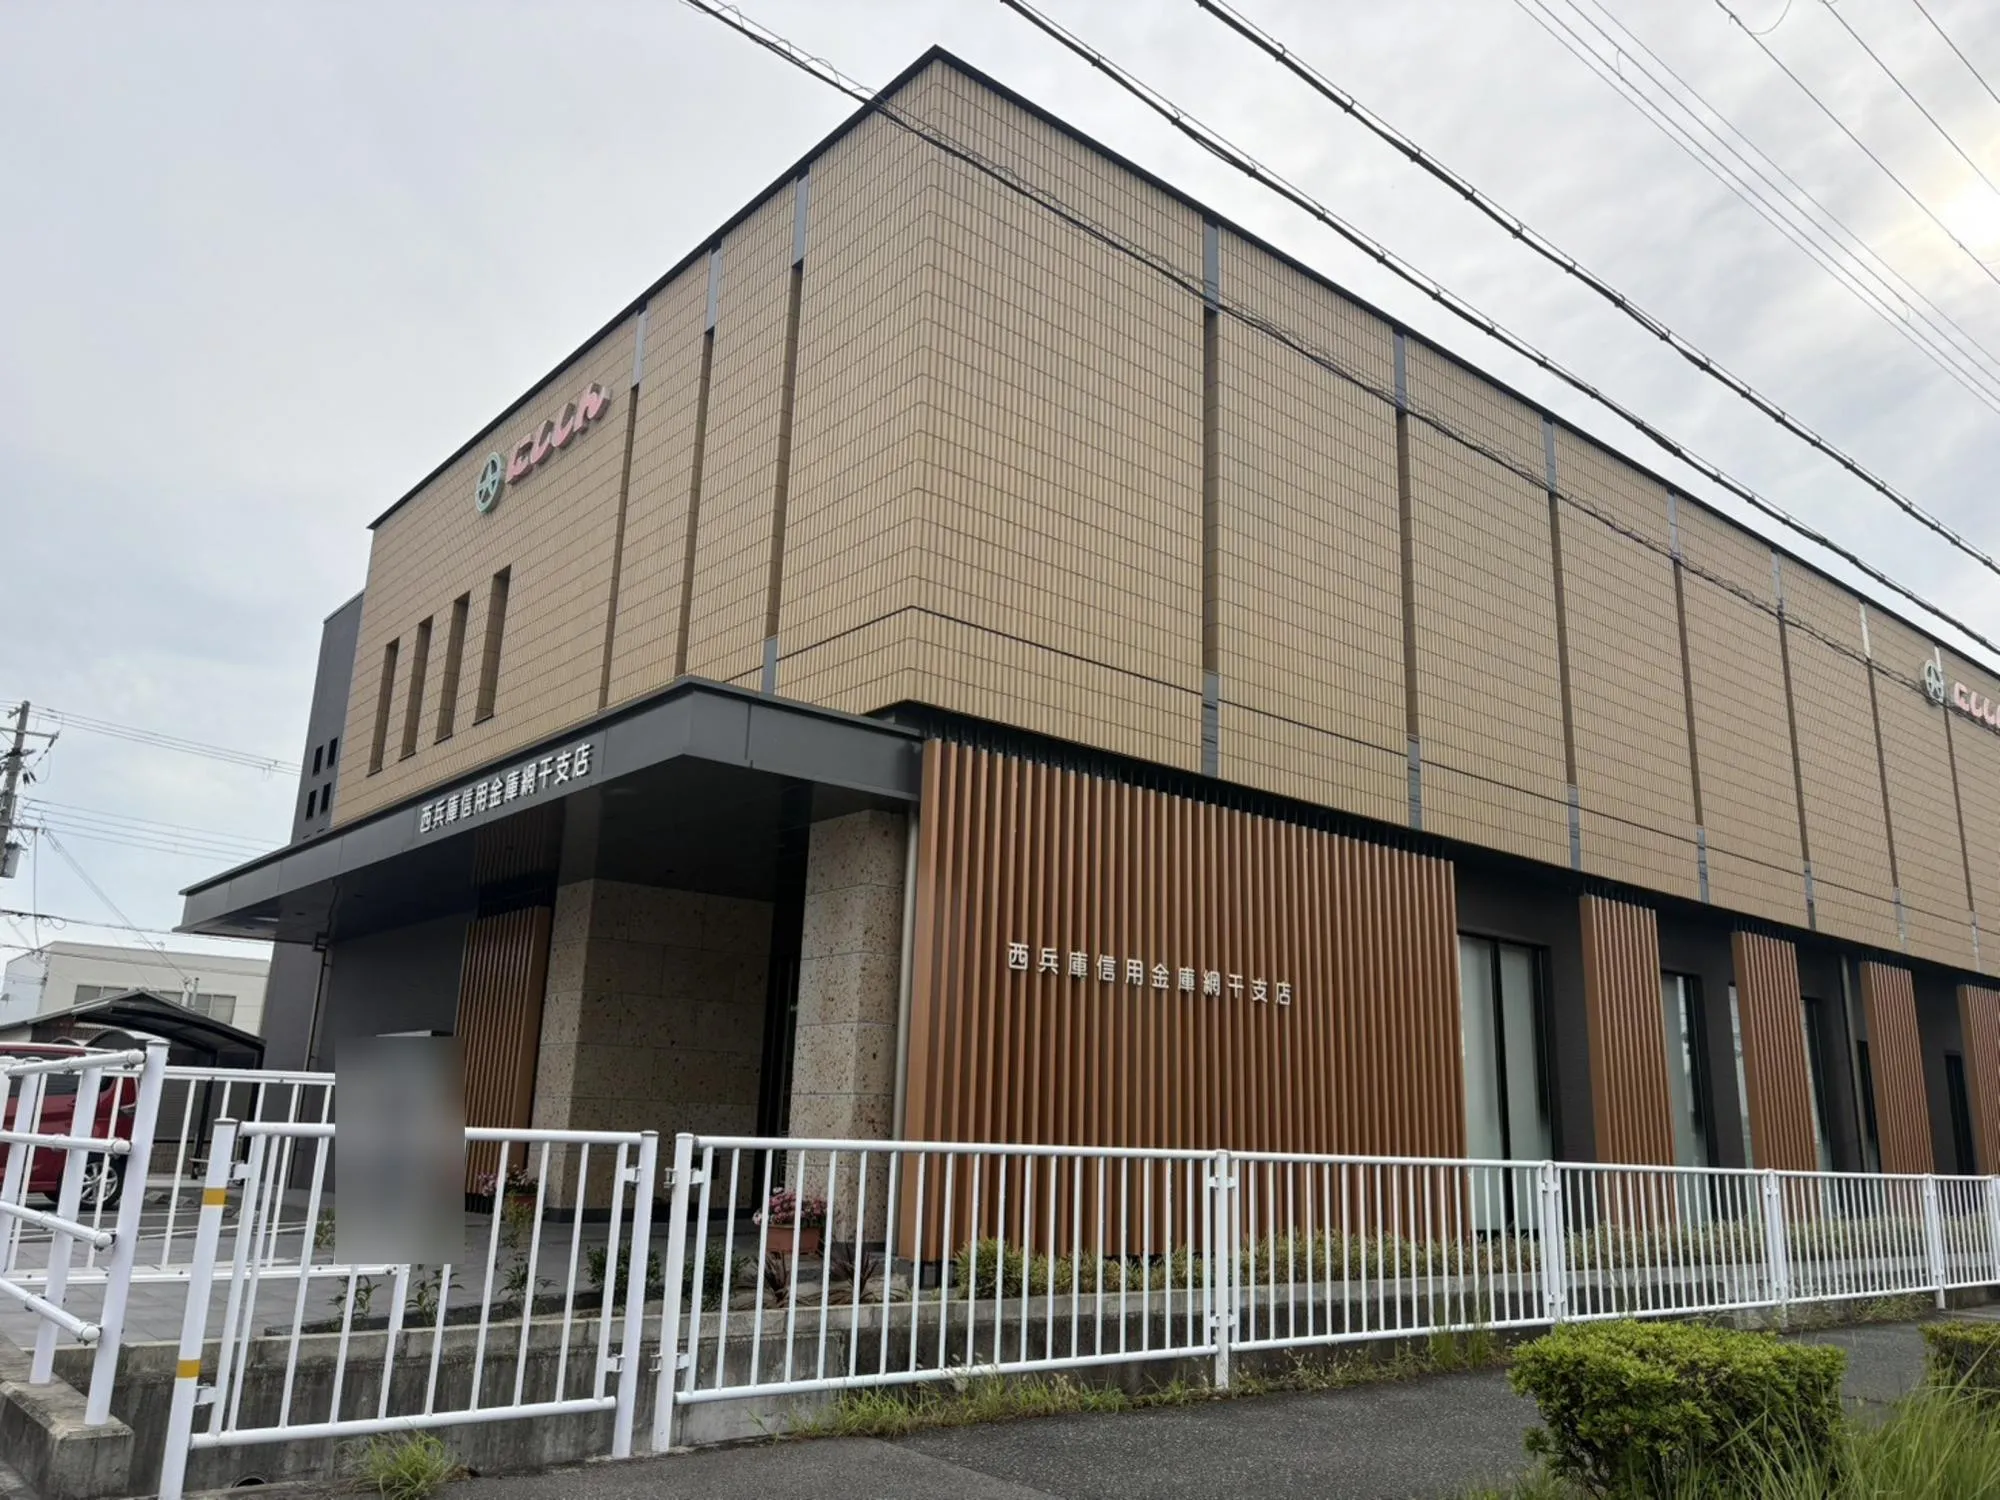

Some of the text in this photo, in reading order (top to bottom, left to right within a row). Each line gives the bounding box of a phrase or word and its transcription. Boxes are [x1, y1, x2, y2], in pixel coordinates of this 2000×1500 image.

[506, 383, 612, 485] にししん
[1953, 681, 2000, 729] にしし
[419, 743, 592, 834] 西兵庫信用金庫網干支店
[1008, 941, 1292, 1006] 西兵庫信用金庫網干支店
